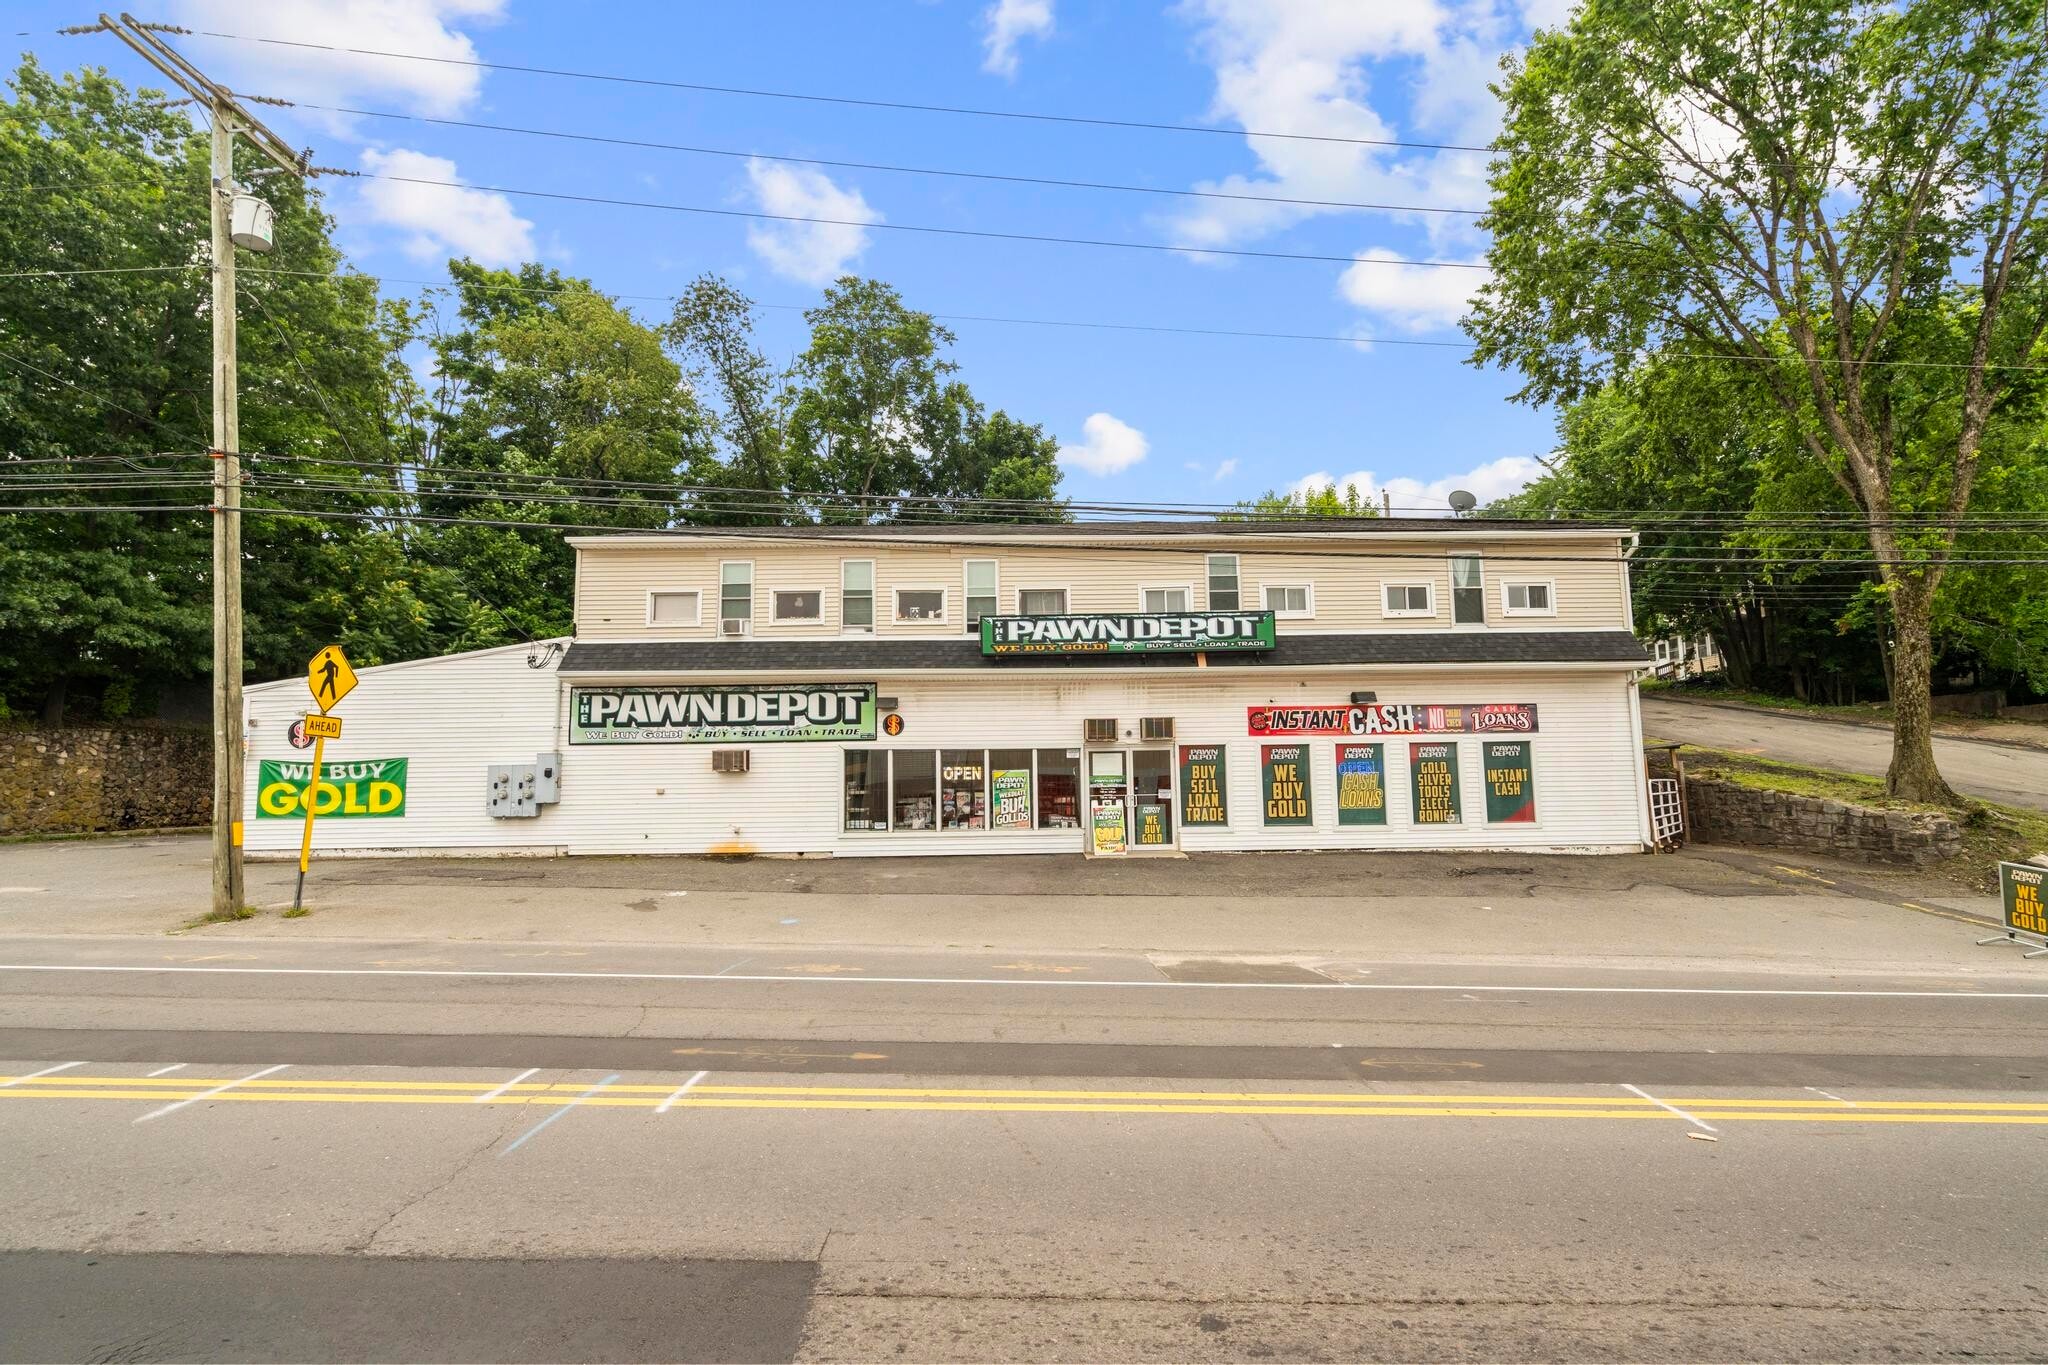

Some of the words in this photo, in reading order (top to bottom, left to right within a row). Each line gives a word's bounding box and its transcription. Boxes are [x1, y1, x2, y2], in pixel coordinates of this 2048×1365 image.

[995, 621, 1003, 641] THE
[1008, 618, 1128, 640] PAWN
[1133, 616, 1259, 639] DEPOT
[993, 644, 1020, 652] WE
[1023, 644, 1057, 652] BUY
[1062, 643, 1107, 651] GOLD!
[580, 695, 589, 723] THE
[590, 693, 721, 723] PAWN
[727, 691, 865, 722] DEPOT
[309, 721, 337, 733] AHEAD
[1270, 709, 1346, 729] INSTANT
[1348, 705, 1414, 735] CASH
[1428, 708, 1445, 729] NO
[1471, 711, 1530, 732] LOANS
[585, 731, 608, 739] WE
[611, 731, 639, 739] BUY
[642, 730, 682, 739] GOLD!
[704, 730, 729, 738] BUY
[741, 729, 767, 737] SELL
[822, 728, 860, 736] TRADE
[330, 762, 388, 780] BUY
[943, 766, 981, 780] OPEN
[1192, 765, 1216, 779] BUY
[1273, 764, 1297, 782] WE
[1420, 762, 1447, 774] GOLD
[1487, 768, 1528, 782] INSTANT
[1191, 779, 1218, 793] SELL
[1342, 773, 1378, 790] CASH
[1418, 773, 1452, 786] SILVER
[1272, 782, 1303, 800] BUY
[1418, 786, 1450, 798] TOOLS
[1494, 782, 1521, 796] CASH
[259, 781, 403, 816] GOLD
[1188, 793, 1219, 807] LOAN
[1340, 789, 1382, 808] LOANS
[1420, 798, 1452, 809] ELECT-
[1186, 807, 1224, 821] TRADE
[1267, 800, 1307, 818] GOLD
[1419, 810, 1455, 822] RONICS
[1145, 815, 1158, 824] WE
[1144, 825, 1161, 834] BUY
[1142, 833, 1163, 843] GOLD
[2016, 884, 2038, 901] WE
[2015, 898, 2044, 917] BUY
[2012, 911, 2047, 932] GOLD
